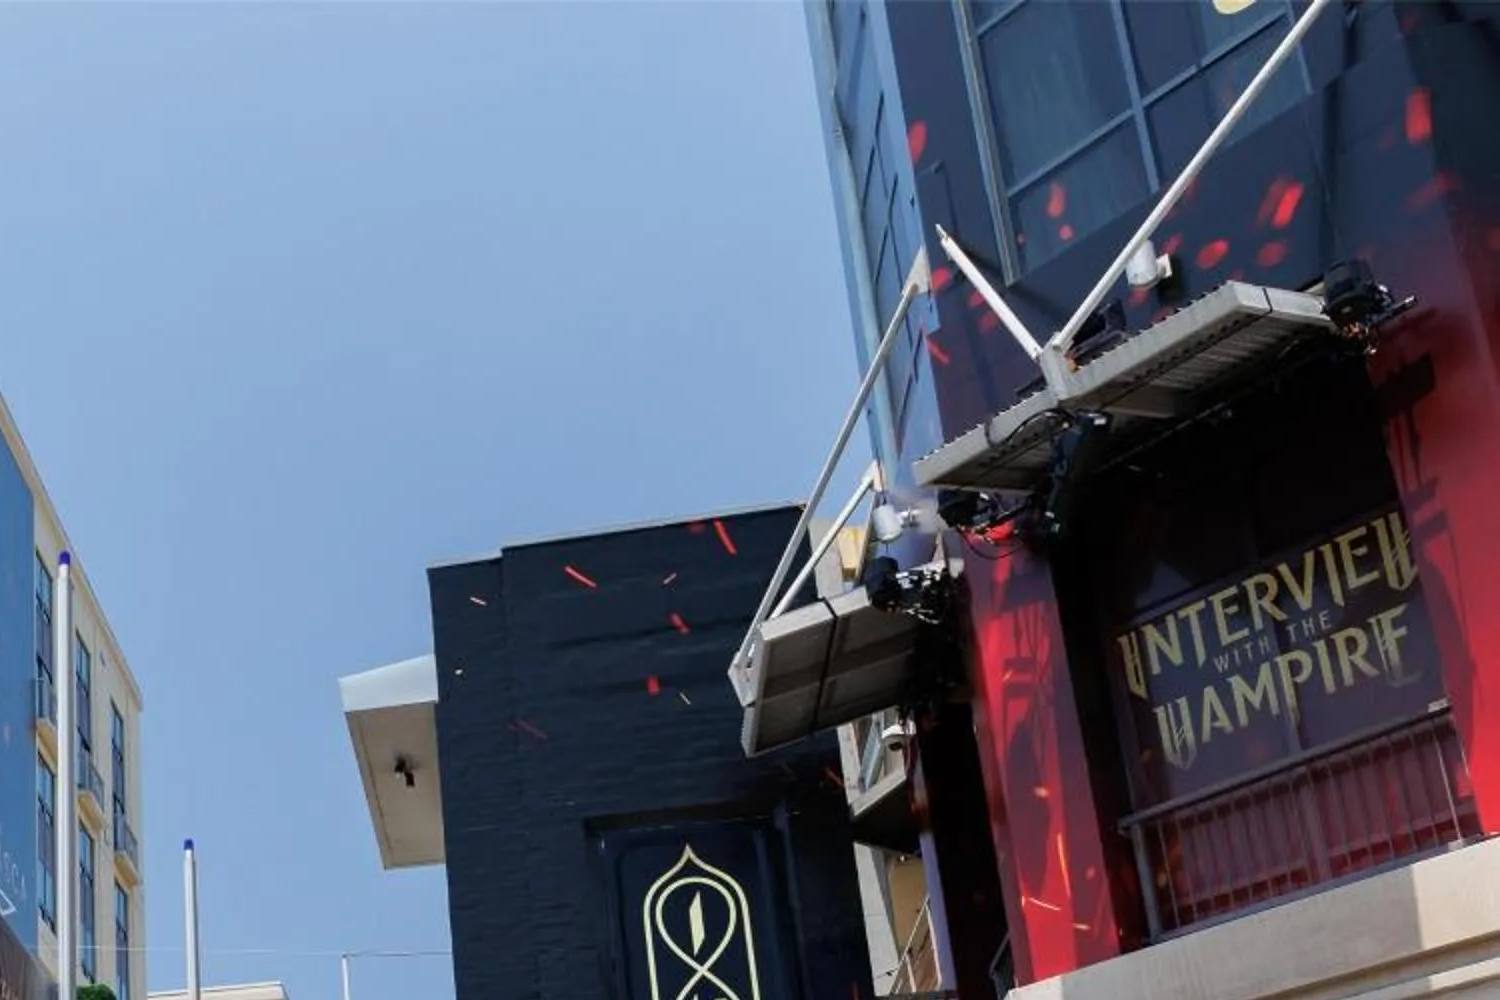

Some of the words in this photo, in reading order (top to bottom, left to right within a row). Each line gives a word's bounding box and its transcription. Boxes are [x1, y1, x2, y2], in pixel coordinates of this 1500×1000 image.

[1116, 511, 1419, 700] INTERVIEW
[1152, 603, 1422, 771] VAMPIRE
[1212, 638, 1271, 674] WITH
[1285, 609, 1333, 642] THE
